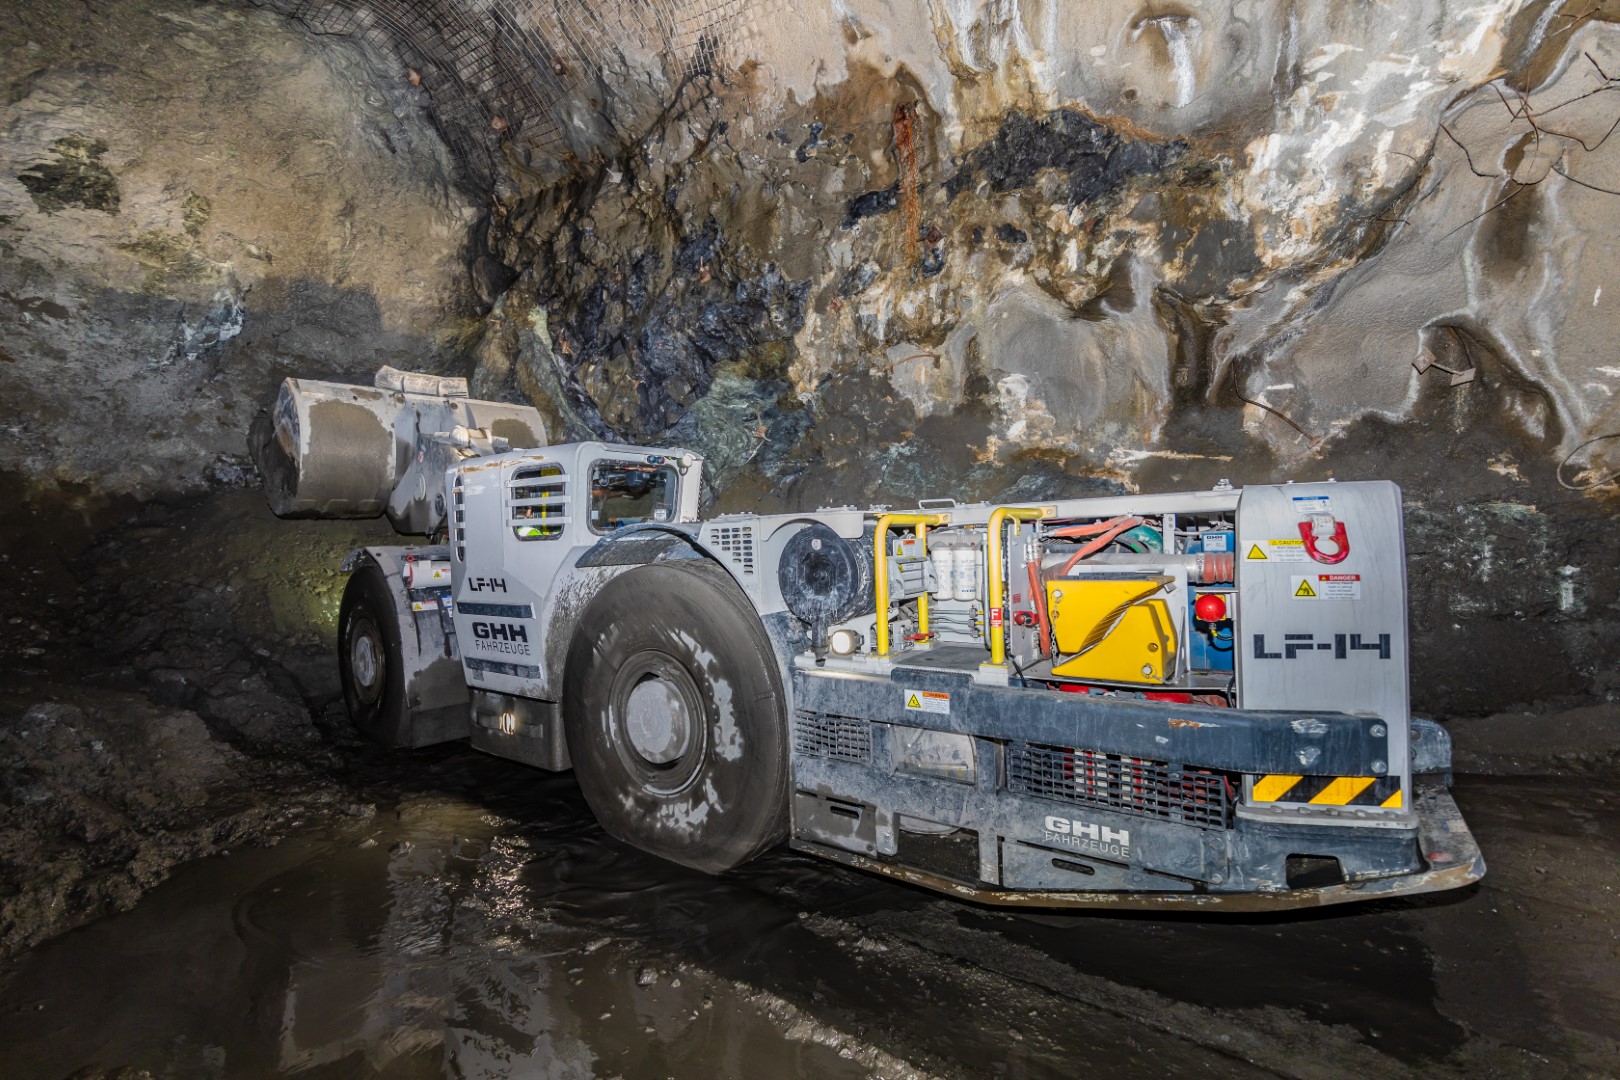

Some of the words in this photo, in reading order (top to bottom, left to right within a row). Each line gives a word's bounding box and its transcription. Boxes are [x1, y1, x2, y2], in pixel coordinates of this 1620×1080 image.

[468, 577, 507, 593] LF-14
[991, 608, 999, 620] F
[472, 622, 528, 643] GHH
[475, 640, 531, 656] FAHRZEUGE
[1253, 633, 1391, 659] LF-14
[1045, 815, 1130, 846] GHH
[1045, 831, 1130, 858] FAHRZEUGE
